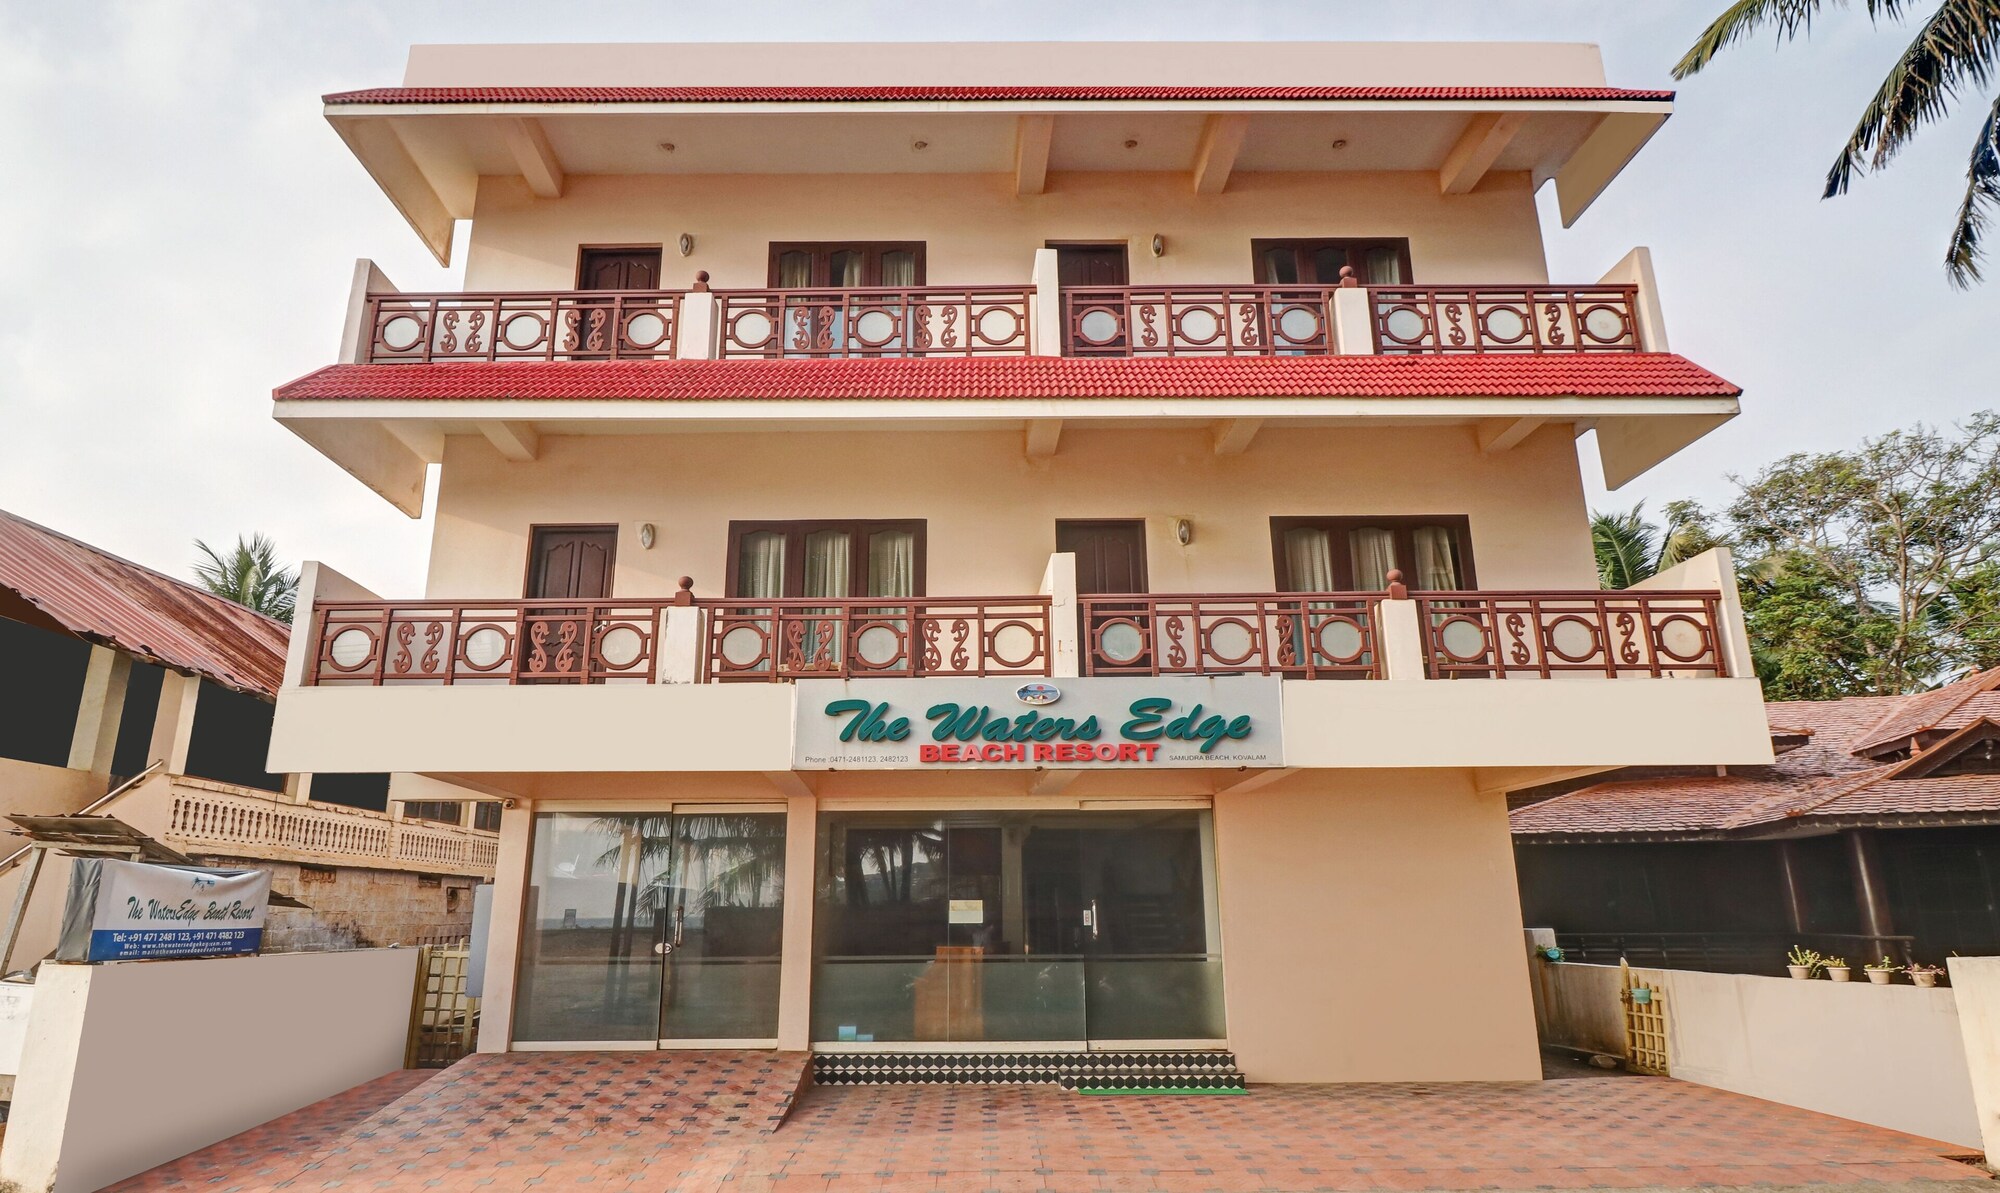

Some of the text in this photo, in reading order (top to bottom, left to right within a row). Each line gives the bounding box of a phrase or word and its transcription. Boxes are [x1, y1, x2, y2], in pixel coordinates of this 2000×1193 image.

[825, 697, 1252, 753] The Waters Edge
[880, 755, 909, 763] 2482123
[920, 743, 1160, 763] BEACH RESORT
[127, 896, 143, 920] The
[228, 900, 255, 920] Resort
[113, 932, 127, 942] Tel:
[128, 933, 142, 942] +91
[144, 933, 158, 942] 471
[159, 932, 176, 941] 2481
[192, 932, 204, 941] +91
[206, 932, 217, 940] 471
[234, 931, 245, 939] 123
